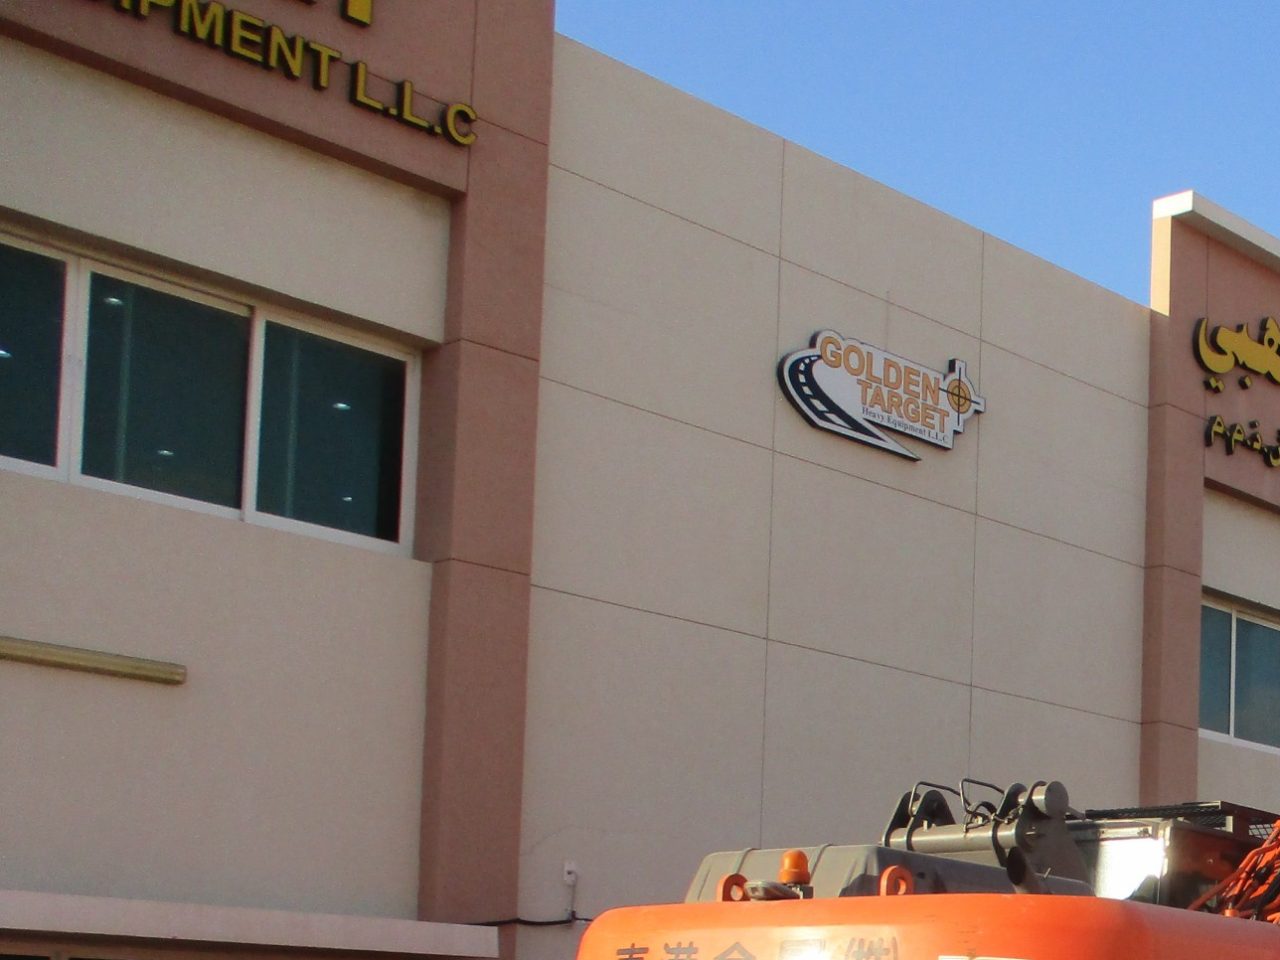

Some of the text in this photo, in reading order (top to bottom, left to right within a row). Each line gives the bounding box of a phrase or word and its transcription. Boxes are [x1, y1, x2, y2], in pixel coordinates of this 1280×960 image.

[352, 60, 478, 146] L.L.C
[820, 336, 940, 406] GOLDEN
[857, 378, 949, 434] TARGET
[862, 406, 885, 422] Heavy
[886, 414, 926, 437] Equipment
